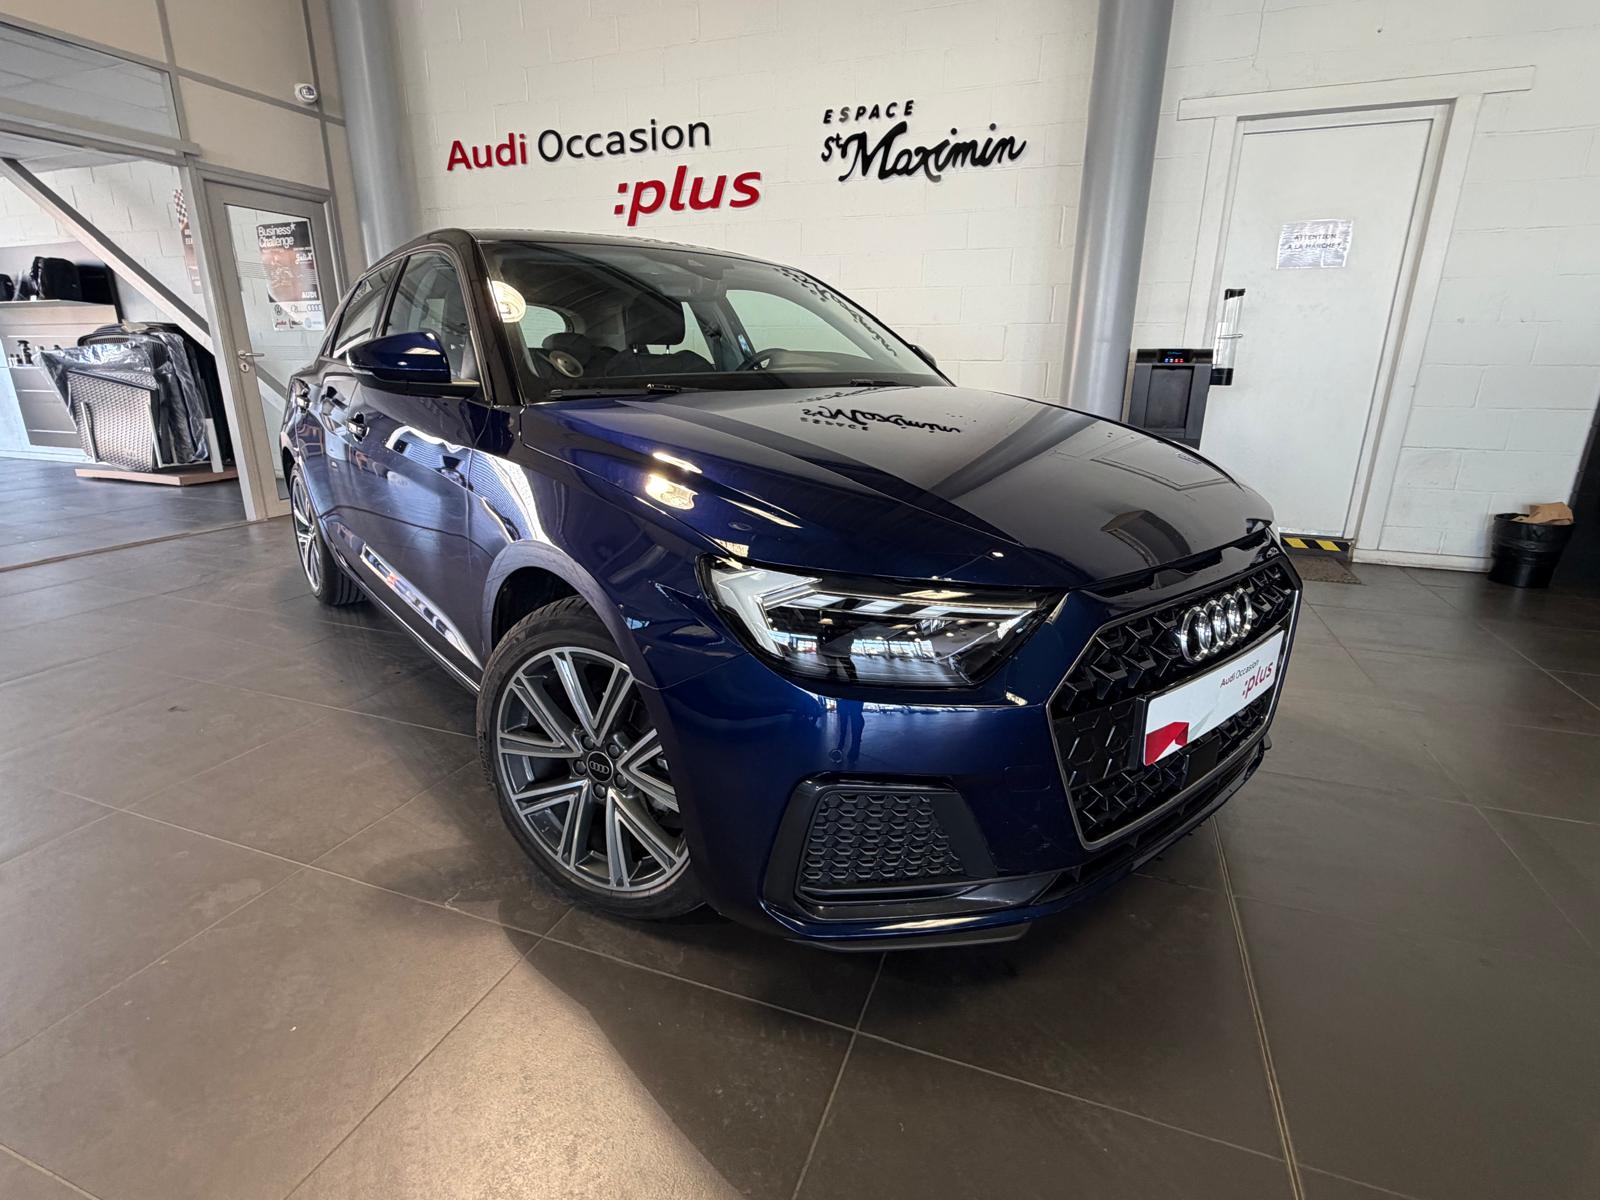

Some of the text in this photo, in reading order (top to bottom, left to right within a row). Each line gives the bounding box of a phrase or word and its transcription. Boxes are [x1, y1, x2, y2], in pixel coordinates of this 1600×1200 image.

[823, 100, 914, 124] ESPACE
[447, 119, 711, 171] Audi Occasion
[821, 121, 1027, 183] St Maximin
[614, 165, 761, 227] :plus
[1220, 672, 1236, 688] Audi
